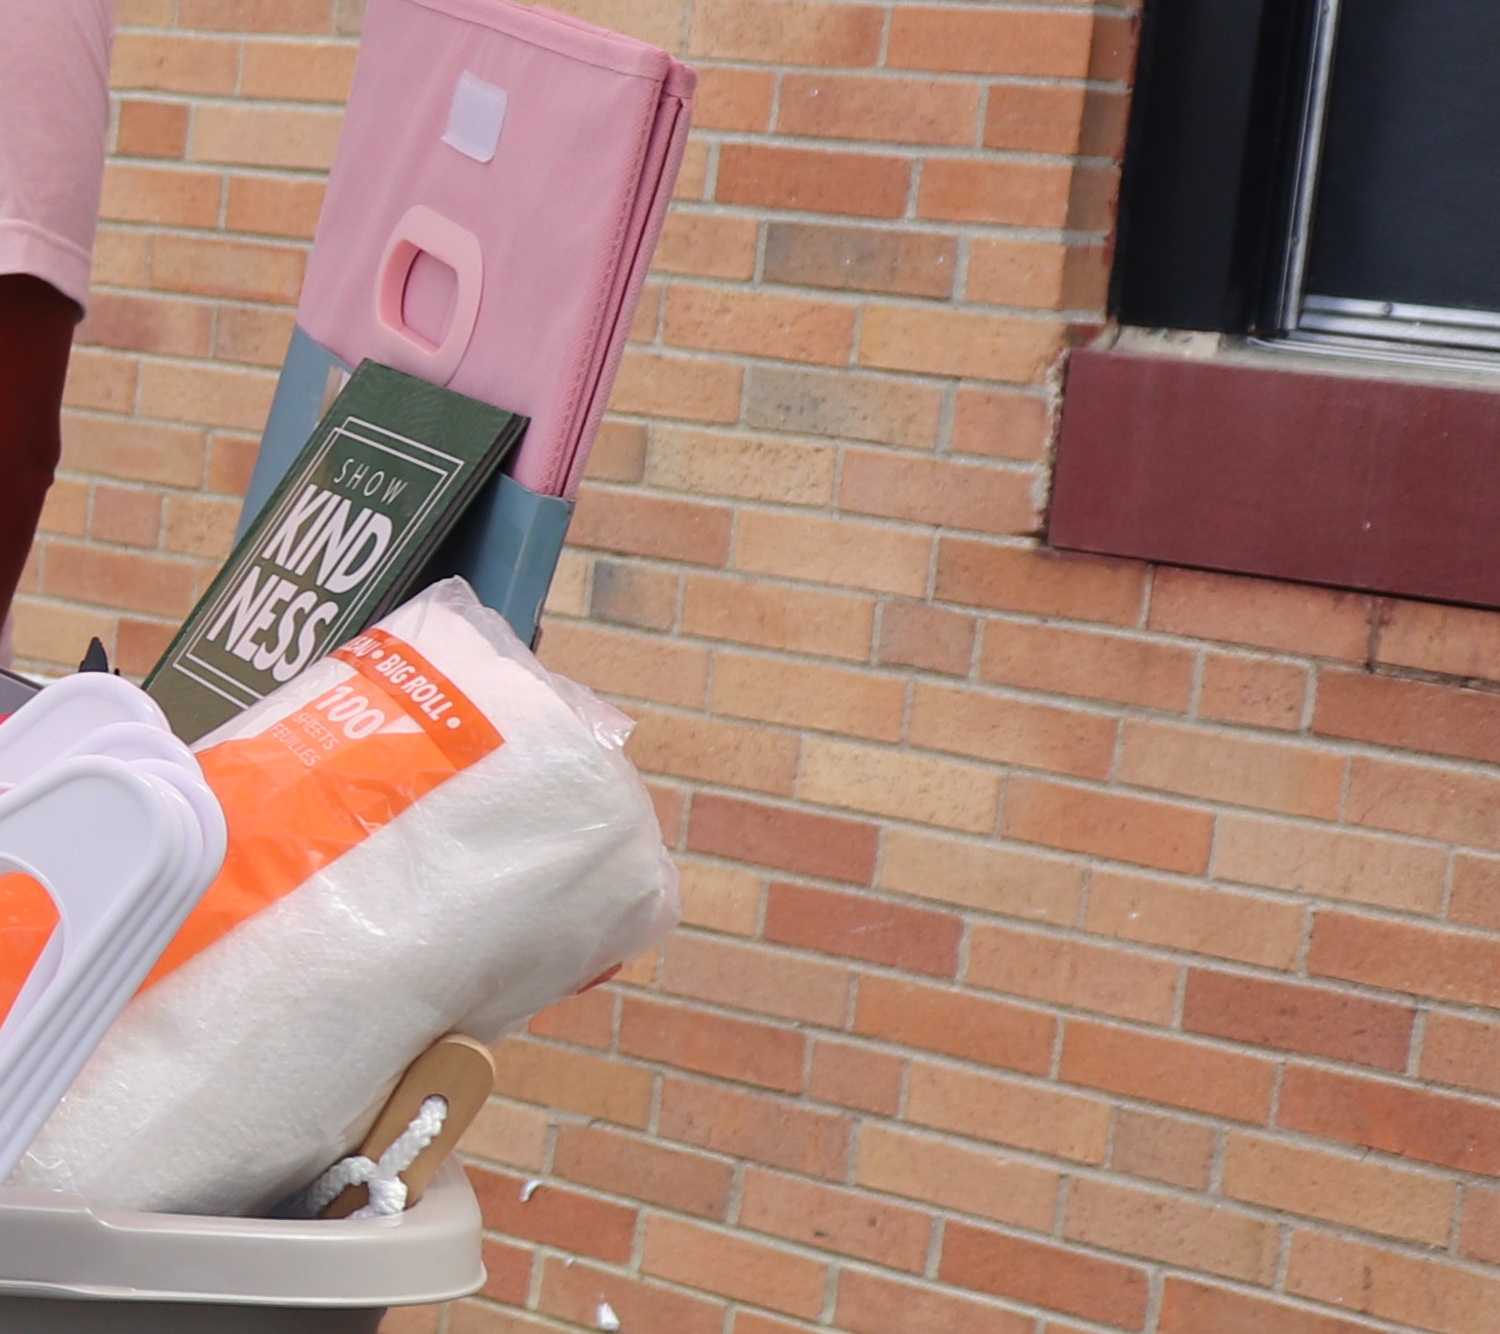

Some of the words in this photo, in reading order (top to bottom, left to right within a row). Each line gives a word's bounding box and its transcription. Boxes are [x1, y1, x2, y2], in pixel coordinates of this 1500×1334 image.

[333, 457, 409, 506] SHOW
[261, 483, 394, 595] KIND
[206, 565, 340, 682] NESS
[315, 684, 386, 741] 100
[375, 653, 406, 685] BIG
[400, 675, 454, 722] ROLL
[271, 723, 323, 769] FEUILLES
[291, 711, 341, 751] SHEETS
